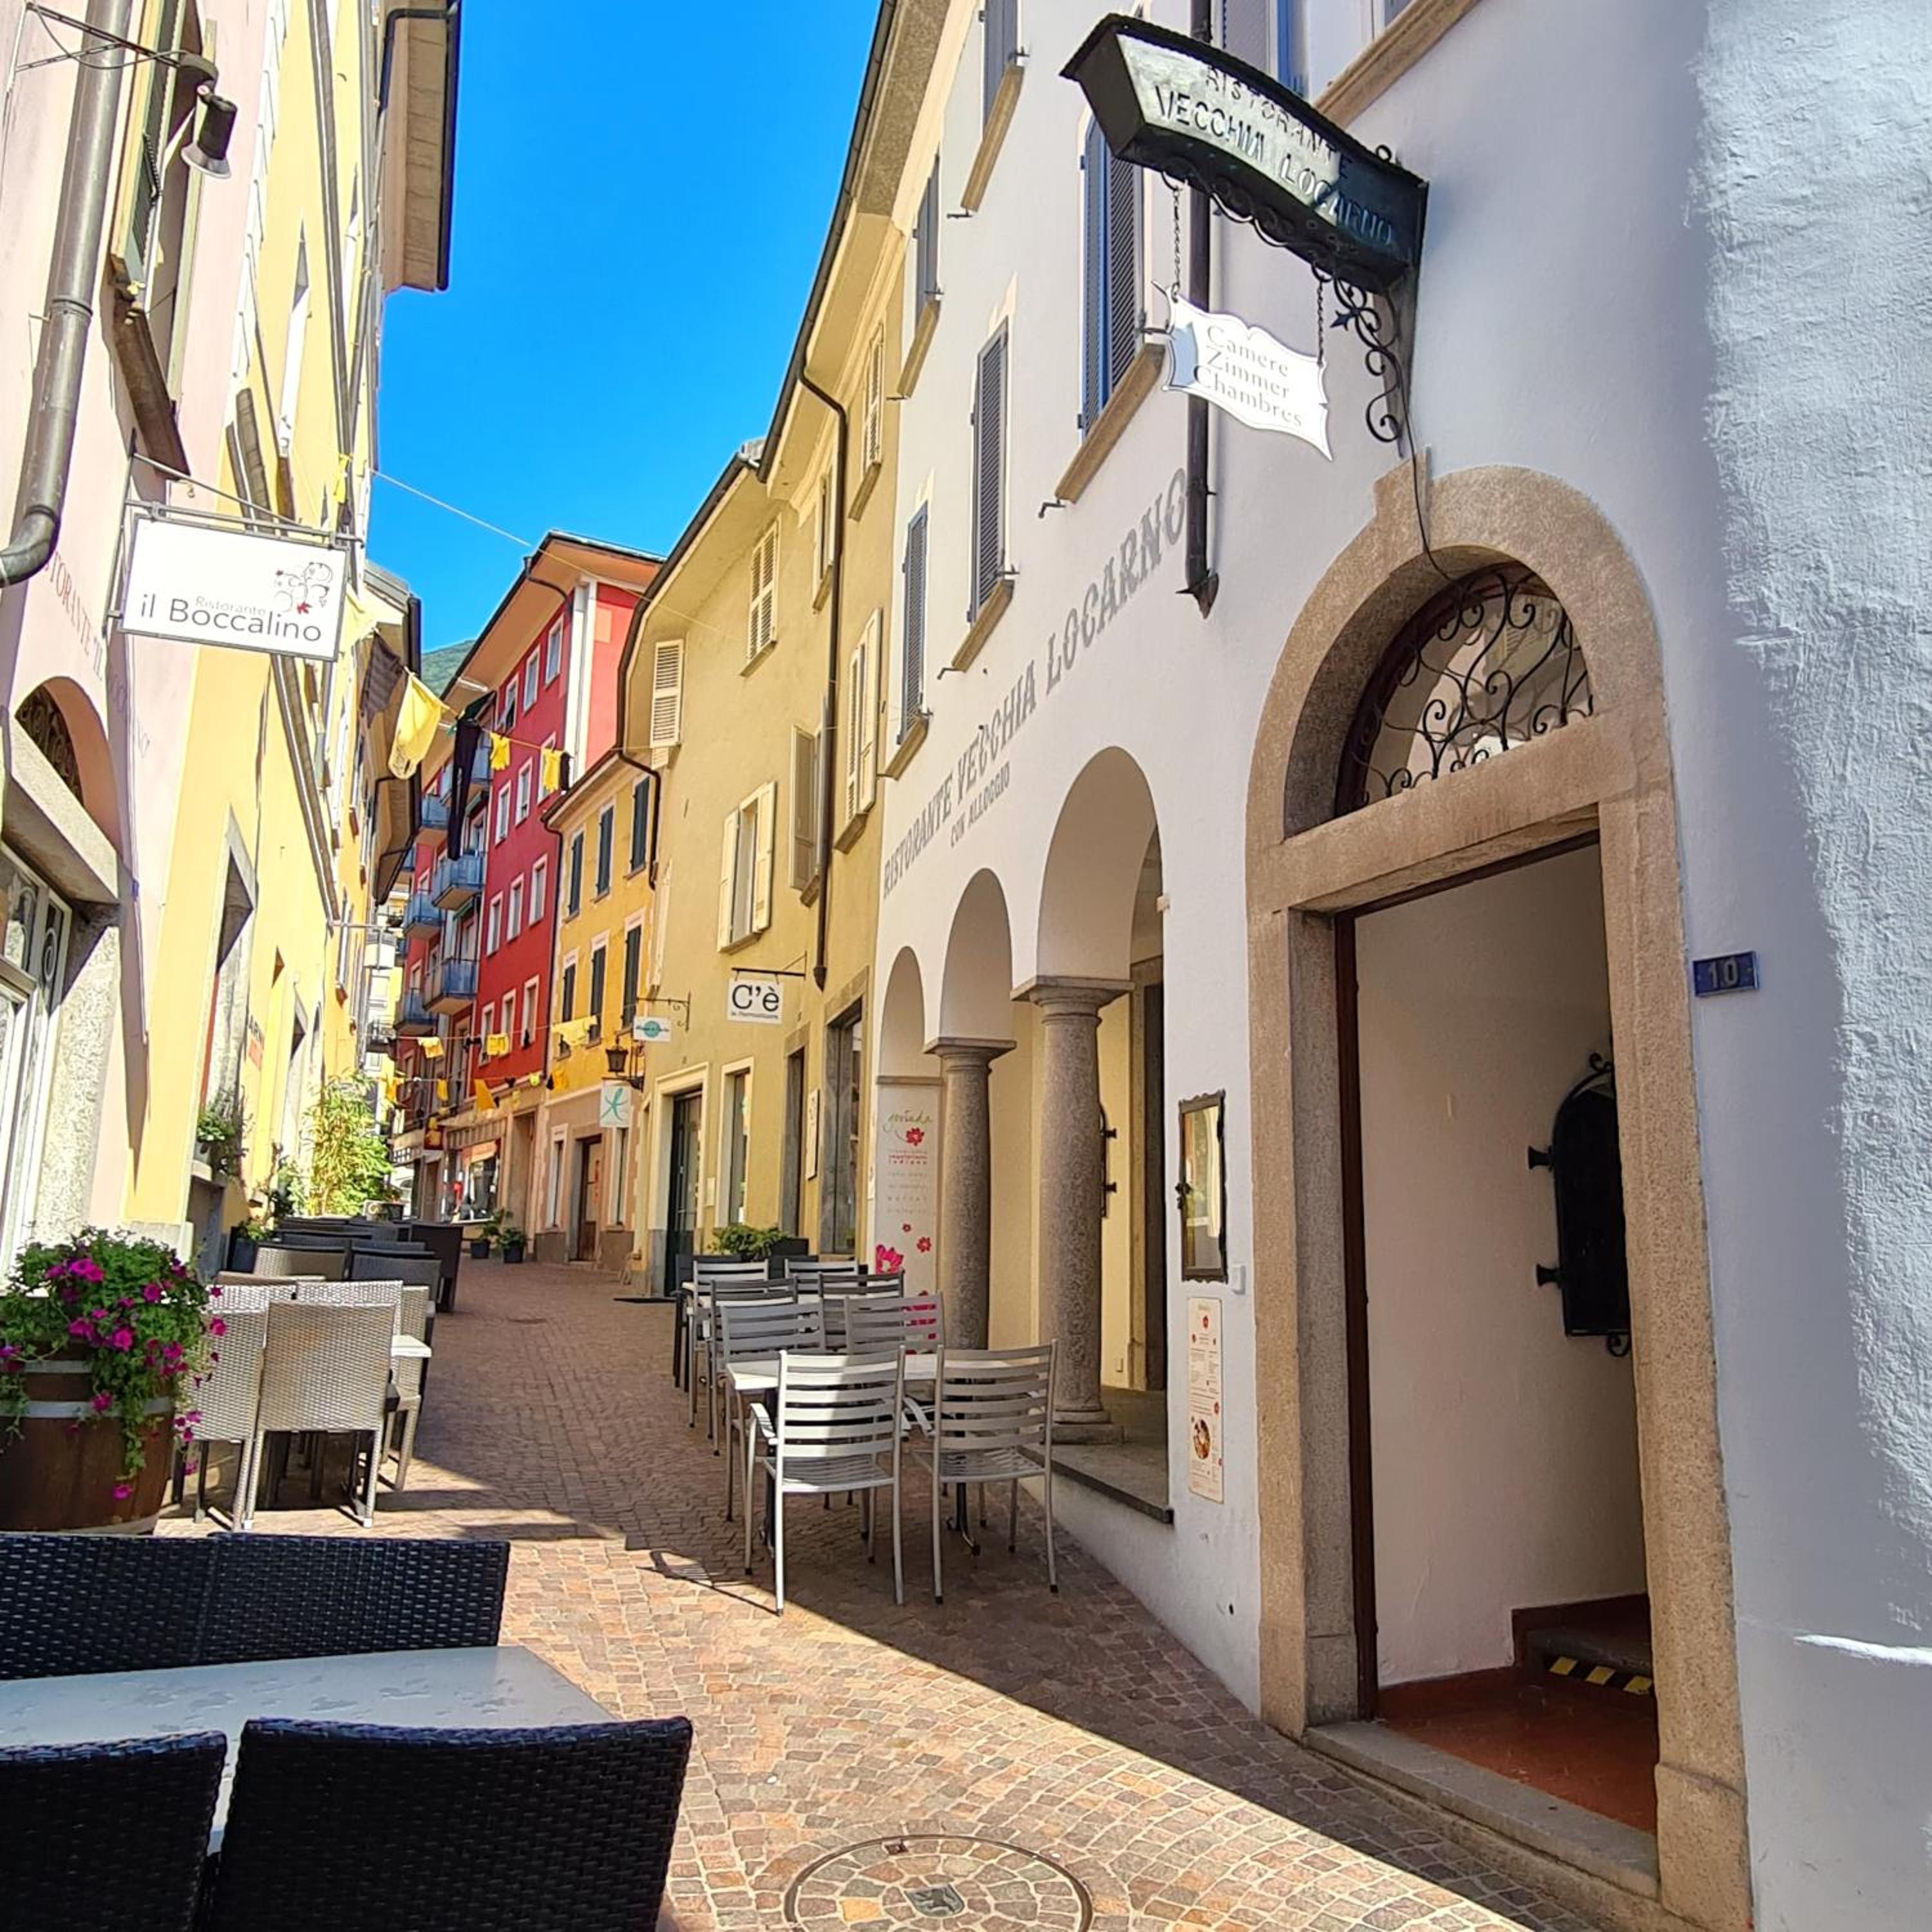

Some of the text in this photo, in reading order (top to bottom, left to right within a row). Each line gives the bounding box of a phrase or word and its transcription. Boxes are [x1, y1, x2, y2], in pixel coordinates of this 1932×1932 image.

[1205, 64, 1352, 180] RISTORANTE
[1155, 84, 1393, 246] VECCHIA LOCARNO
[1206, 345, 1291, 399] Zimmer
[1207, 325, 1289, 377] Camere
[1193, 365, 1302, 428] Chambres
[140, 593, 321, 642] il Boccalino
[195, 595, 266, 616] Ristorante
[883, 468, 1186, 900] RISTORANTE VECCHIA LOCARNO
[950, 761, 1011, 849] CON ALLOGGIO
[732, 984, 780, 1012] C'è
[1709, 958, 1738, 989] 10
